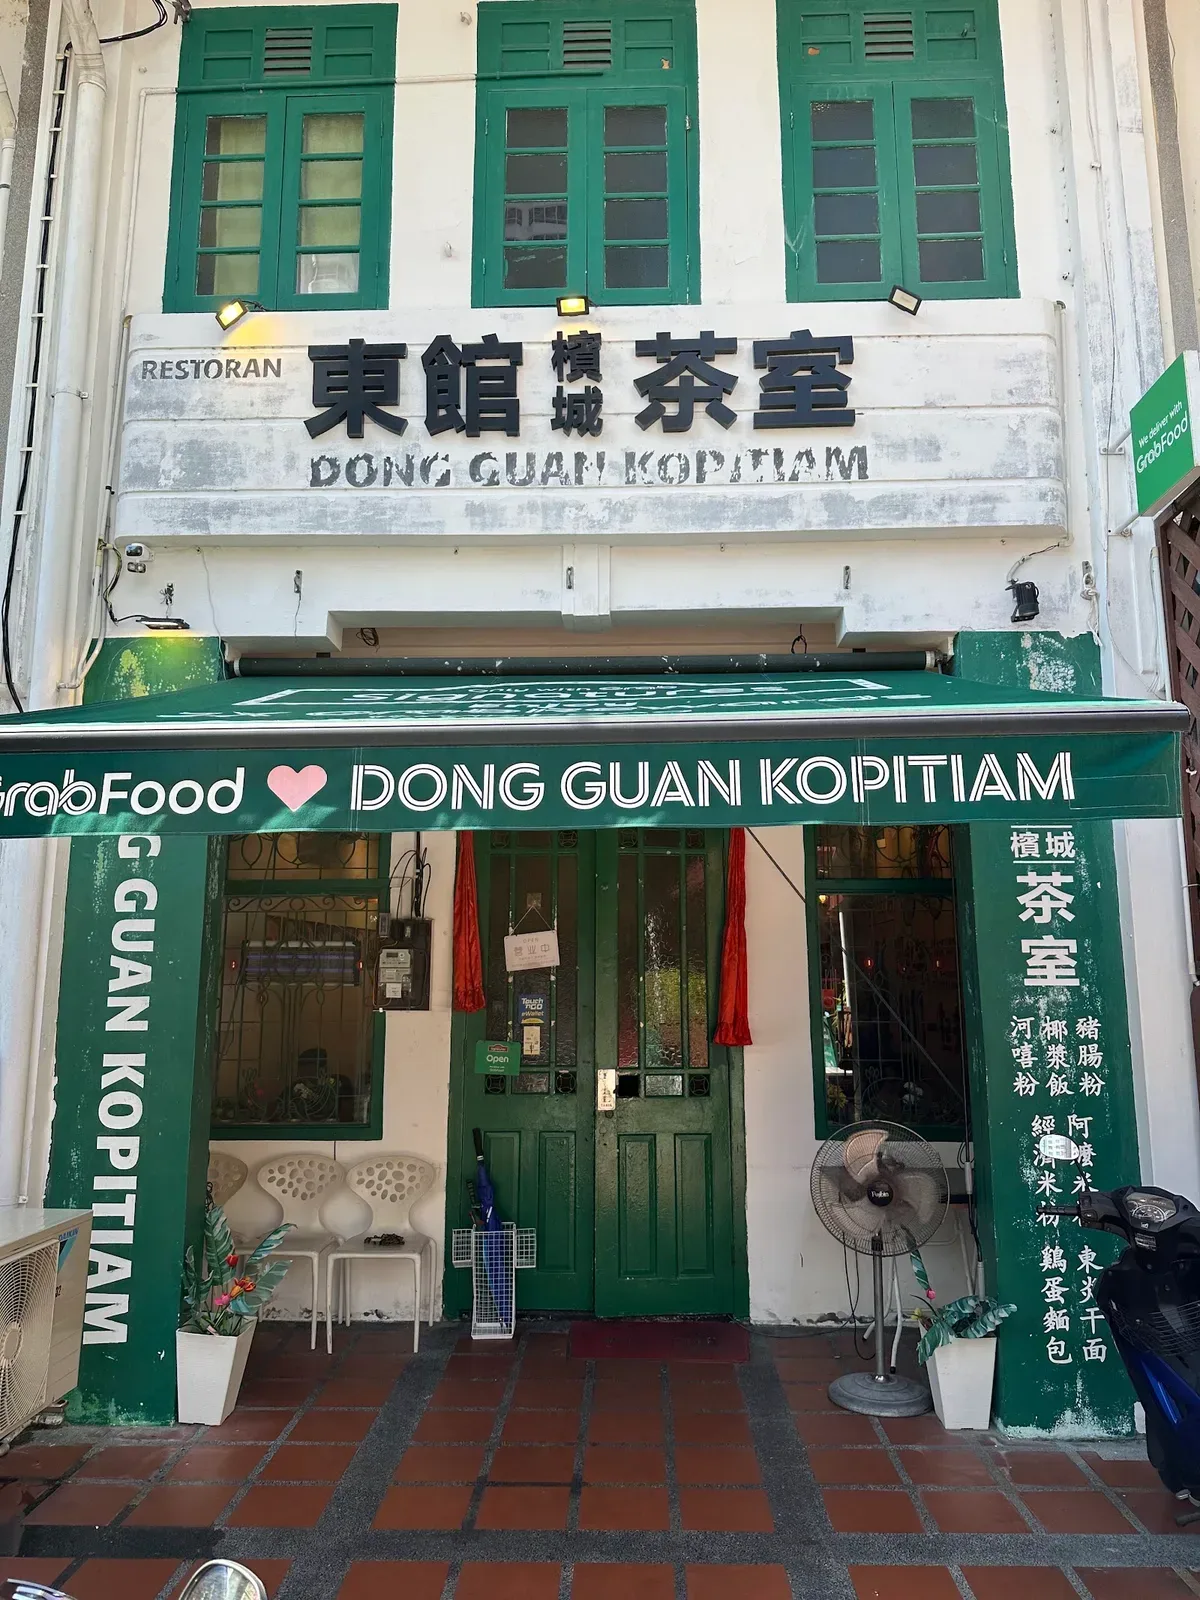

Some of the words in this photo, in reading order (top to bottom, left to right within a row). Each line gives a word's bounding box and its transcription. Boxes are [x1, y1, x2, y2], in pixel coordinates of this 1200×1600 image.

[142, 358, 282, 380] RESTORAN
[304, 333, 524, 440] 東館
[551, 330, 604, 437] 檳城
[634, 329, 855, 433] 茶室
[1136, 410, 1189, 474] GrabFood
[1138, 432, 1150, 449] We
[1148, 413, 1169, 439] deliver
[1168, 400, 1183, 420] with
[310, 451, 451, 488] DONG
[469, 451, 606, 487] GUAN
[625, 445, 869, 485] KOPITIAM
[0, 768, 245, 817] rabFood
[350, 762, 545, 812] DONG
[560, 758, 742, 810] GUAN
[760, 752, 1075, 806] KOPITIAM
[1010, 831, 1076, 858] 檳城
[105, 878, 158, 1032] GUAN
[1017, 871, 1080, 988] 茶室
[486, 1054, 509, 1064] Open
[83, 1053, 147, 1345] KOPITIAM
